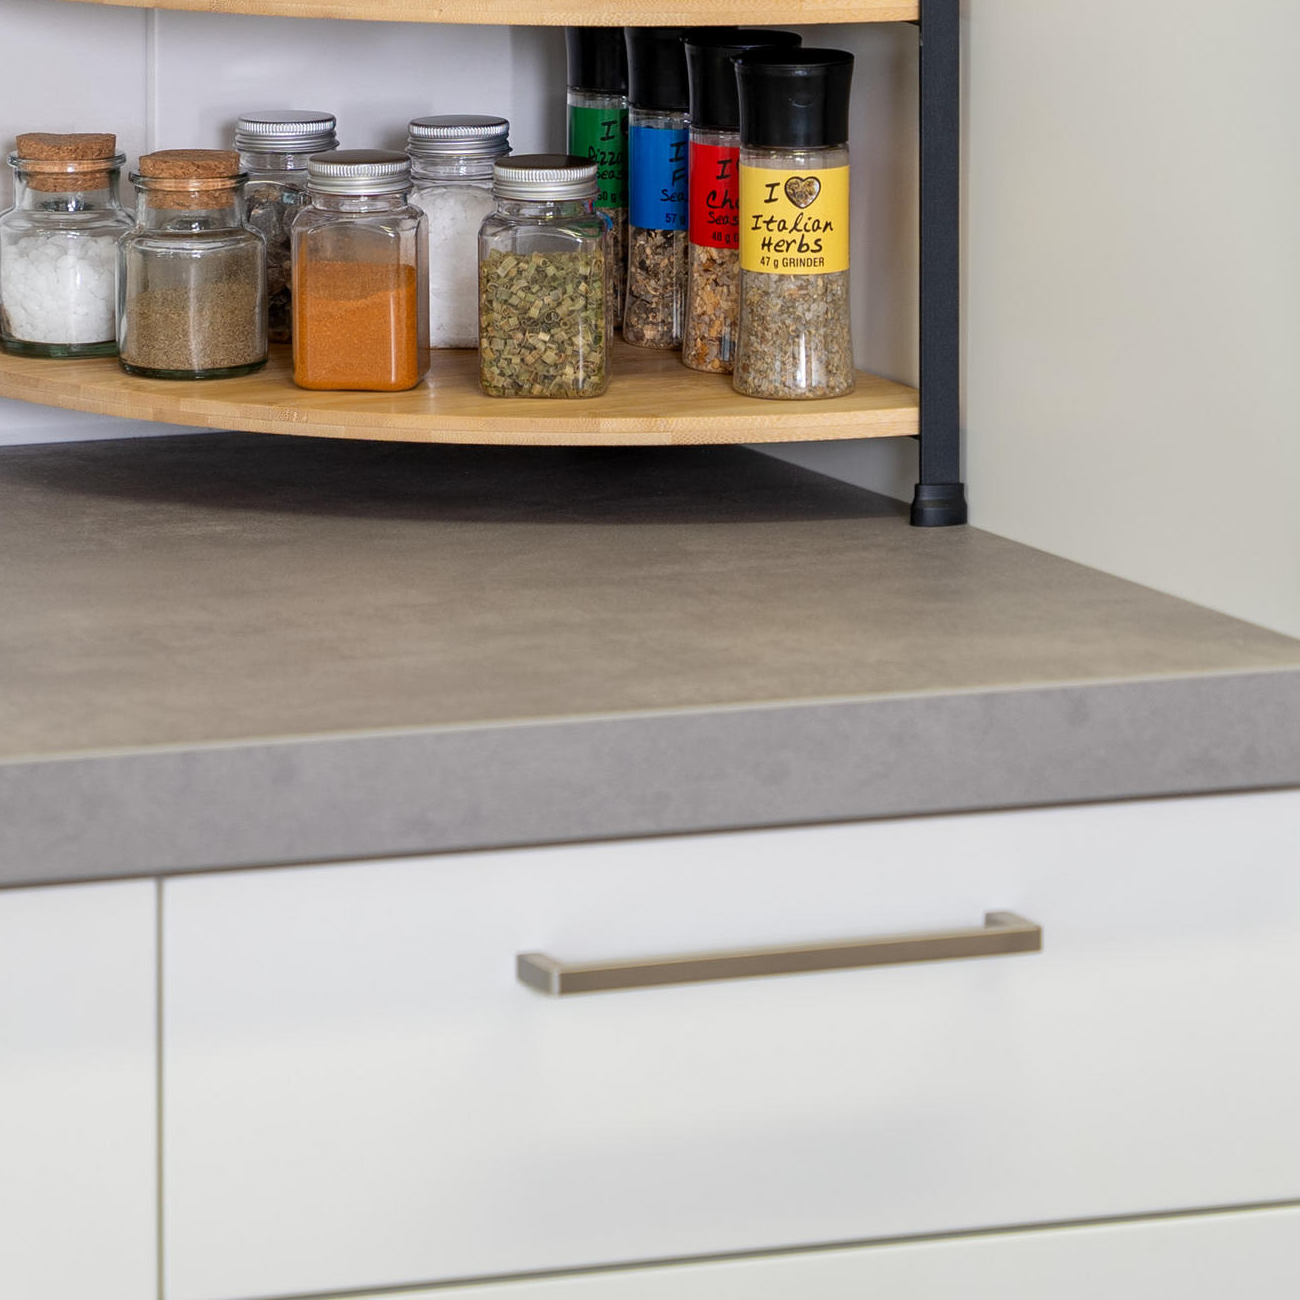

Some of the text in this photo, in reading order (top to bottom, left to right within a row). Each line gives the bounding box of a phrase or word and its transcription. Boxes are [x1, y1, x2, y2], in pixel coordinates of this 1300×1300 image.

[716, 159, 733, 180] I
[764, 182, 780, 203] I
[751, 211, 833, 234] Italian
[761, 233, 823, 253] Herbs
[760, 256, 825, 269] 47 g GRINDER
